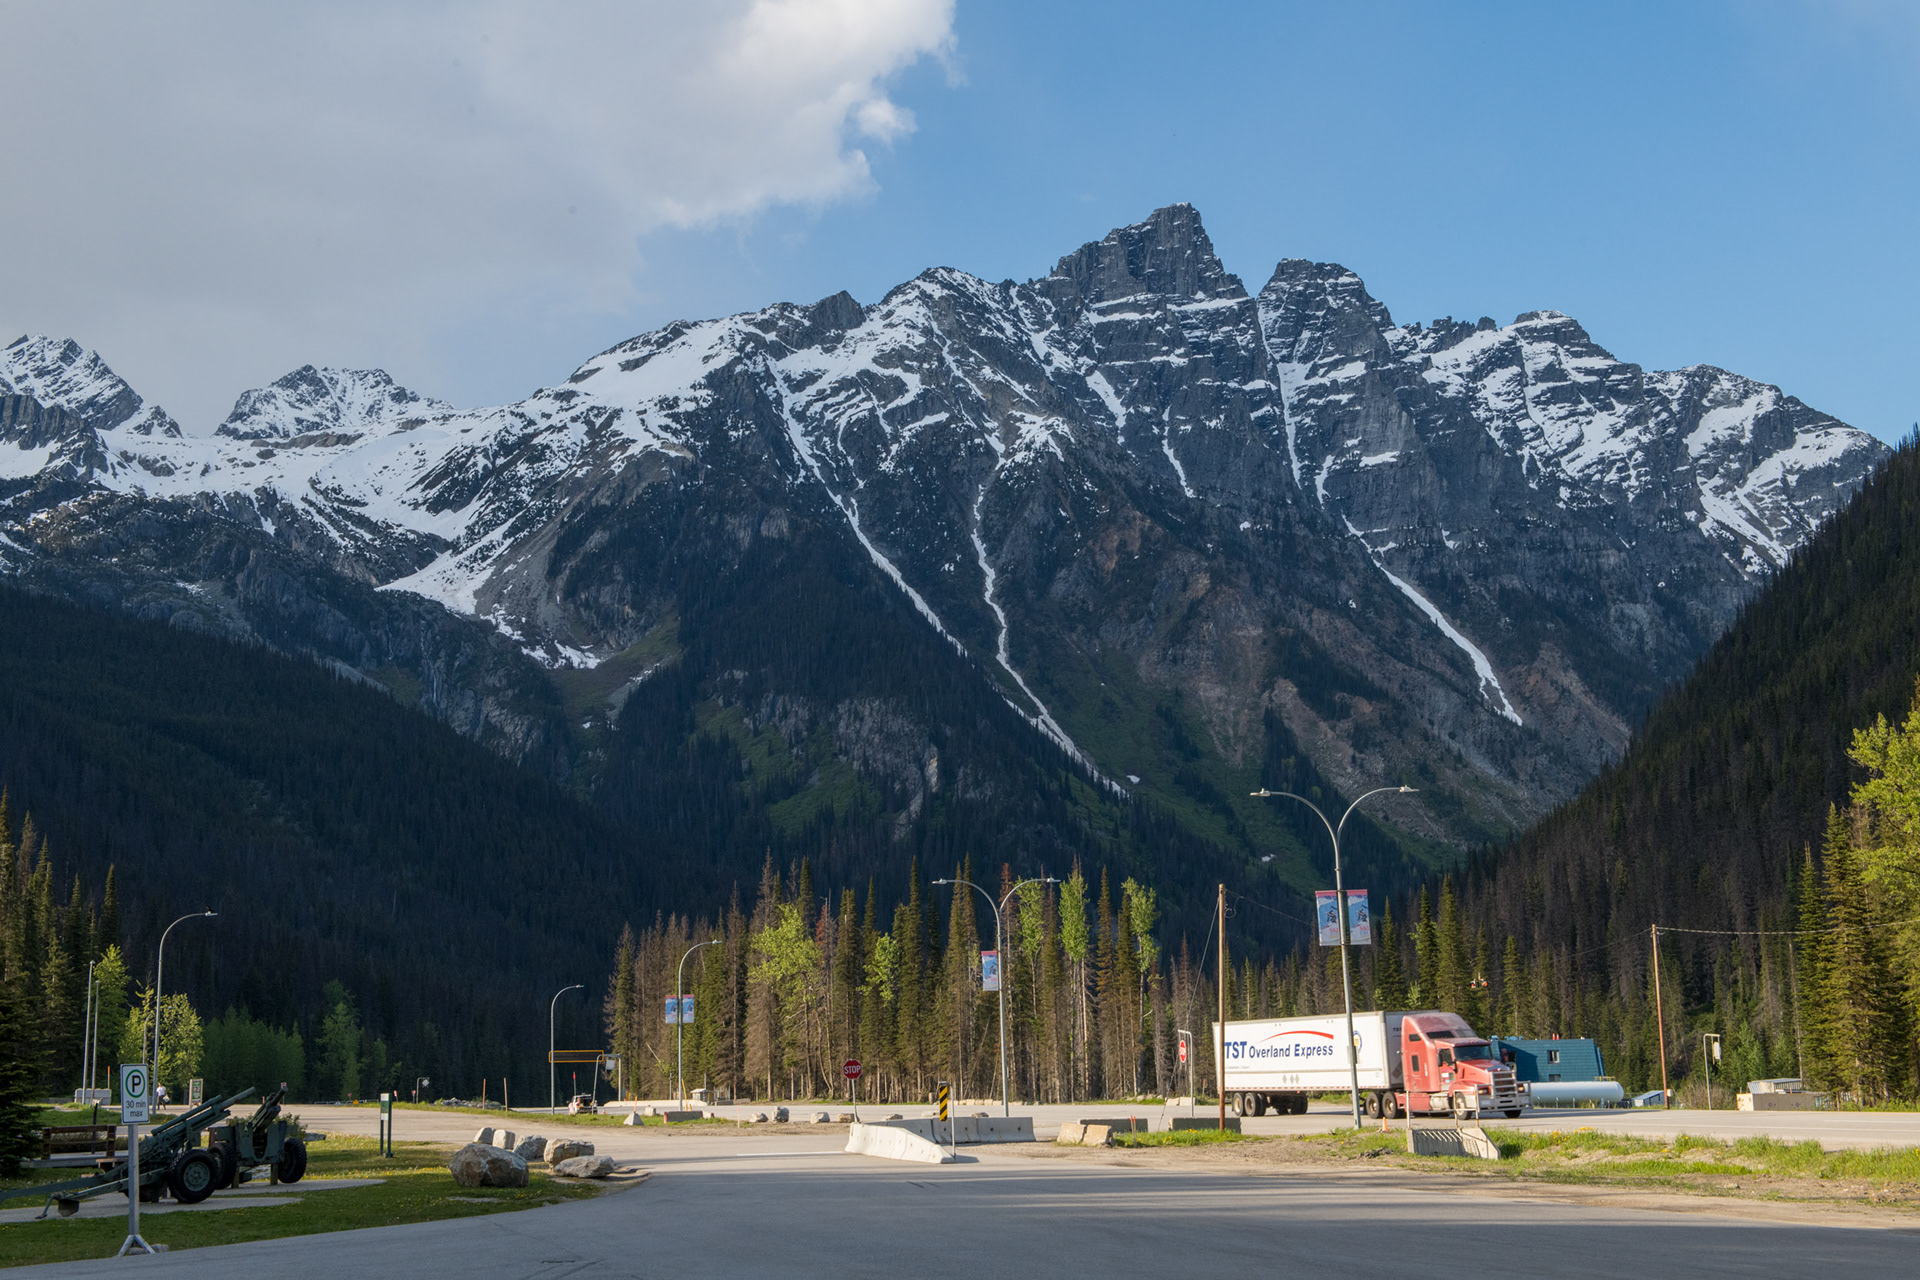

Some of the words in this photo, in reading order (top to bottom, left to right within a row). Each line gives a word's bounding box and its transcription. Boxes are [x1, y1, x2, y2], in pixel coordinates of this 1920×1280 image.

[1225, 1041, 1247, 1059] TST
[1249, 1044, 1291, 1058] Overland
[1294, 1043, 1334, 1059] Express
[844, 1065, 861, 1074] STOP
[132, 1075, 141, 1093] P
[136, 1100, 146, 1108] min
